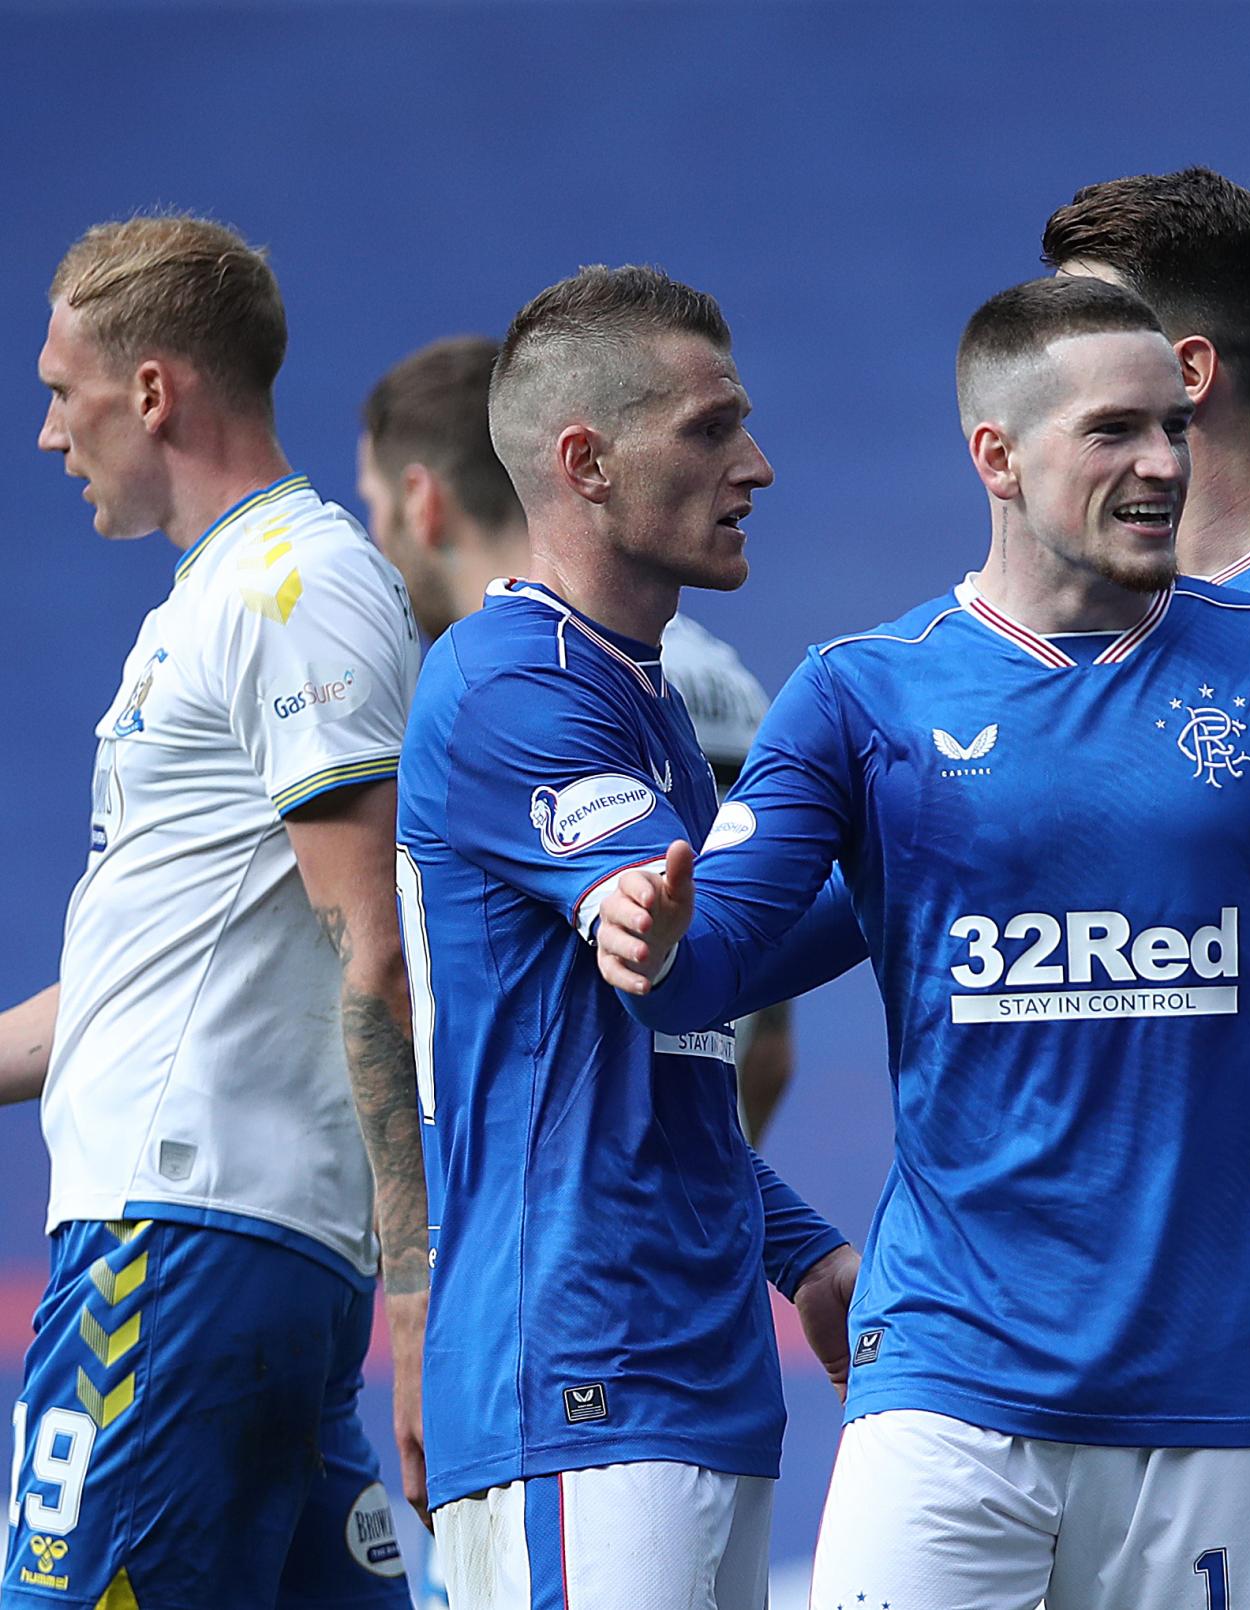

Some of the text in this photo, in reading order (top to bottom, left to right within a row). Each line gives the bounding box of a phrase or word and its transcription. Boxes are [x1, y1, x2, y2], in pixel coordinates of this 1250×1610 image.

[273, 680, 346, 720] GasSure
[558, 789, 649, 832] PREMIERSHIP
[949, 907, 1239, 988] 32Red
[999, 993, 1197, 1016] STAY IN CONTROL
[678, 1033, 709, 1051] STAY
[8, 1400, 98, 1537] 19
[20, 1566, 69, 1591] hummel
